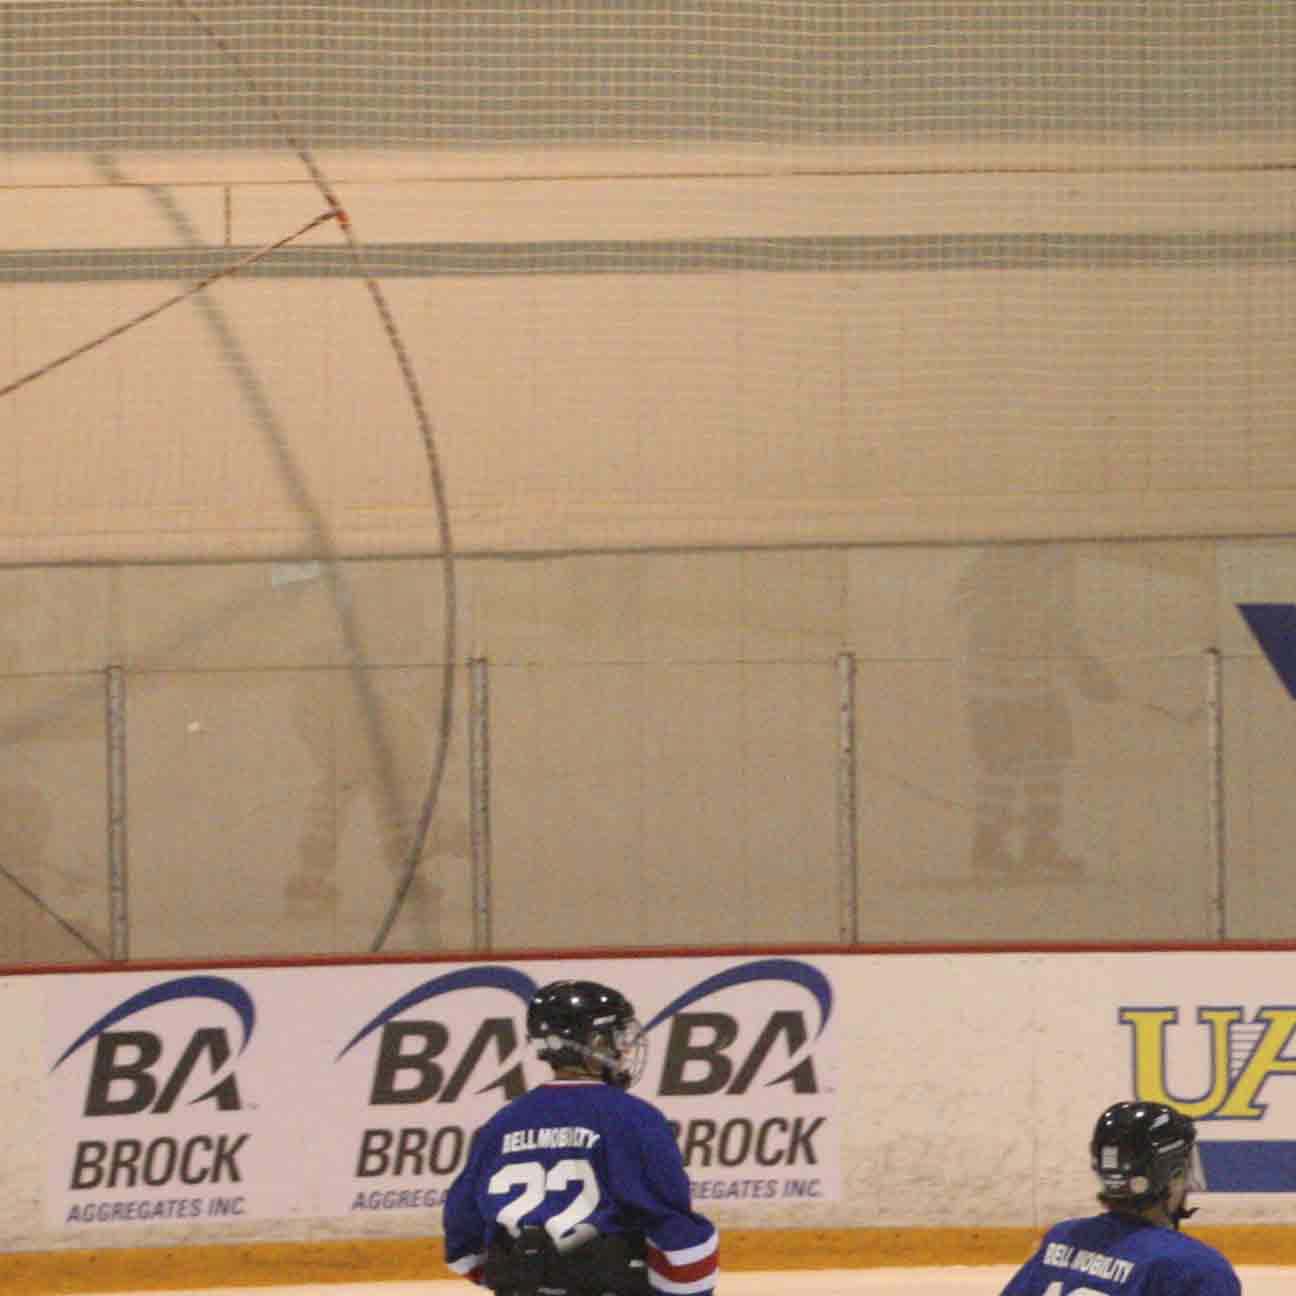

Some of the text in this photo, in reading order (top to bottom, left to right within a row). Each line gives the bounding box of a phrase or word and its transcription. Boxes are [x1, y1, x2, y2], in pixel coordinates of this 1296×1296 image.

[82, 1026, 243, 1118] BA
[368, 1017, 529, 1106] BA
[657, 1010, 819, 1097] BA
[68, 1132, 252, 1190] BROCK
[355, 1125, 465, 1178] BRO
[65, 1197, 203, 1224] AGGREGATES
[351, 1188, 449, 1211] AGGREG
[487, 1159, 600, 1251] 22
